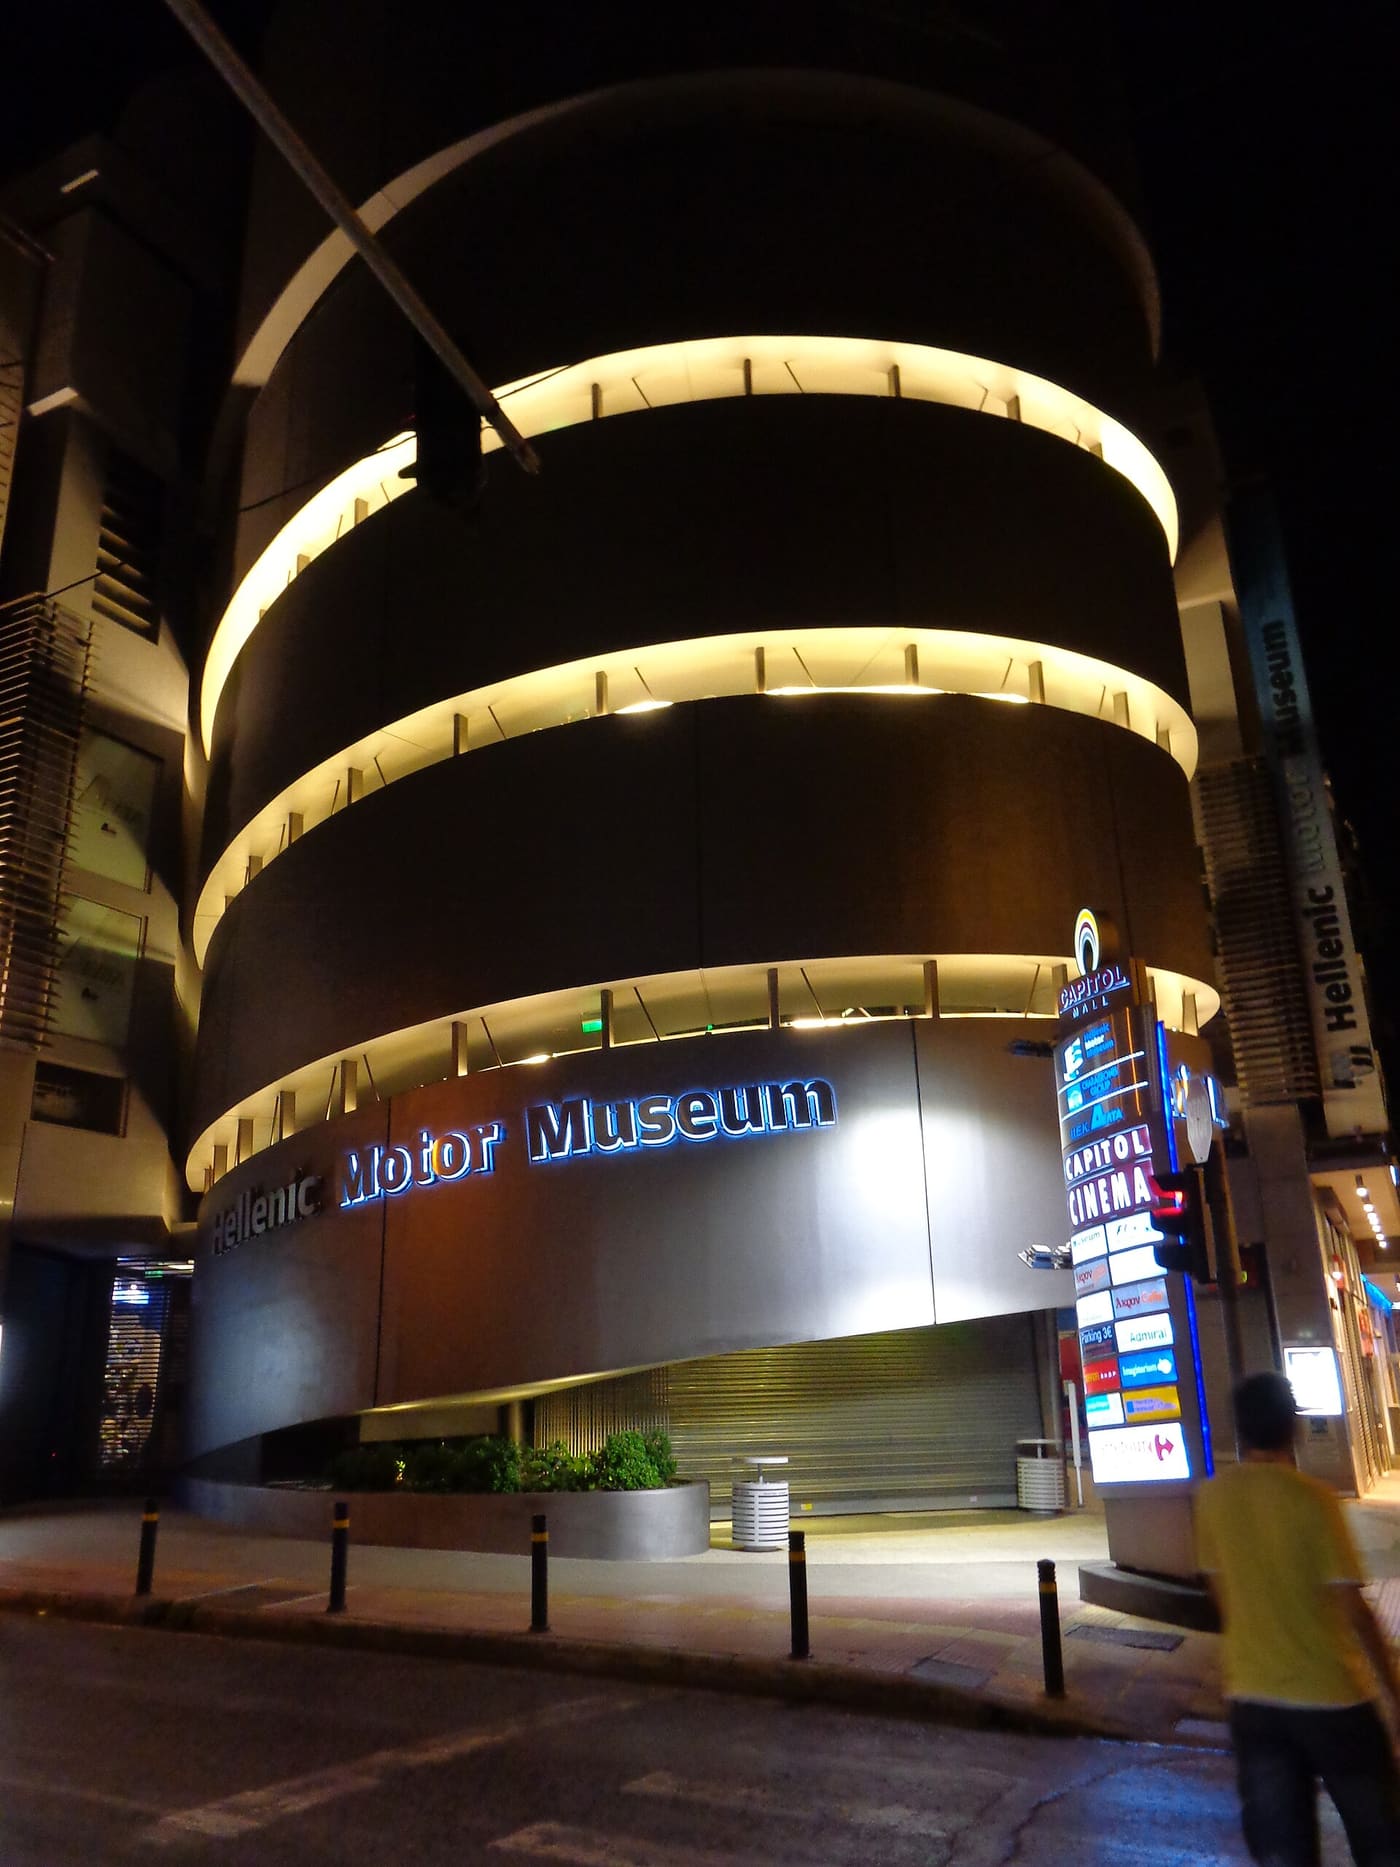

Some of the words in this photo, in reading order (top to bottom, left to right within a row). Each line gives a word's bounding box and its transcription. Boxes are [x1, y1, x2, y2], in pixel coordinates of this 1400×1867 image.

[1262, 618, 1305, 757] Museum
[1303, 884, 1357, 1032] Hellenic
[1061, 966, 1127, 1009] CAPITOL
[1072, 995, 1109, 1019] MALL
[211, 1168, 323, 1257] Hellenic
[339, 1122, 505, 1209] Motor
[526, 1078, 837, 1163] Museum
[1065, 1130, 1145, 1181] CAPITOL
[1069, 1166, 1151, 1226] CINEMA
[1129, 1327, 1167, 1343] Admiral
